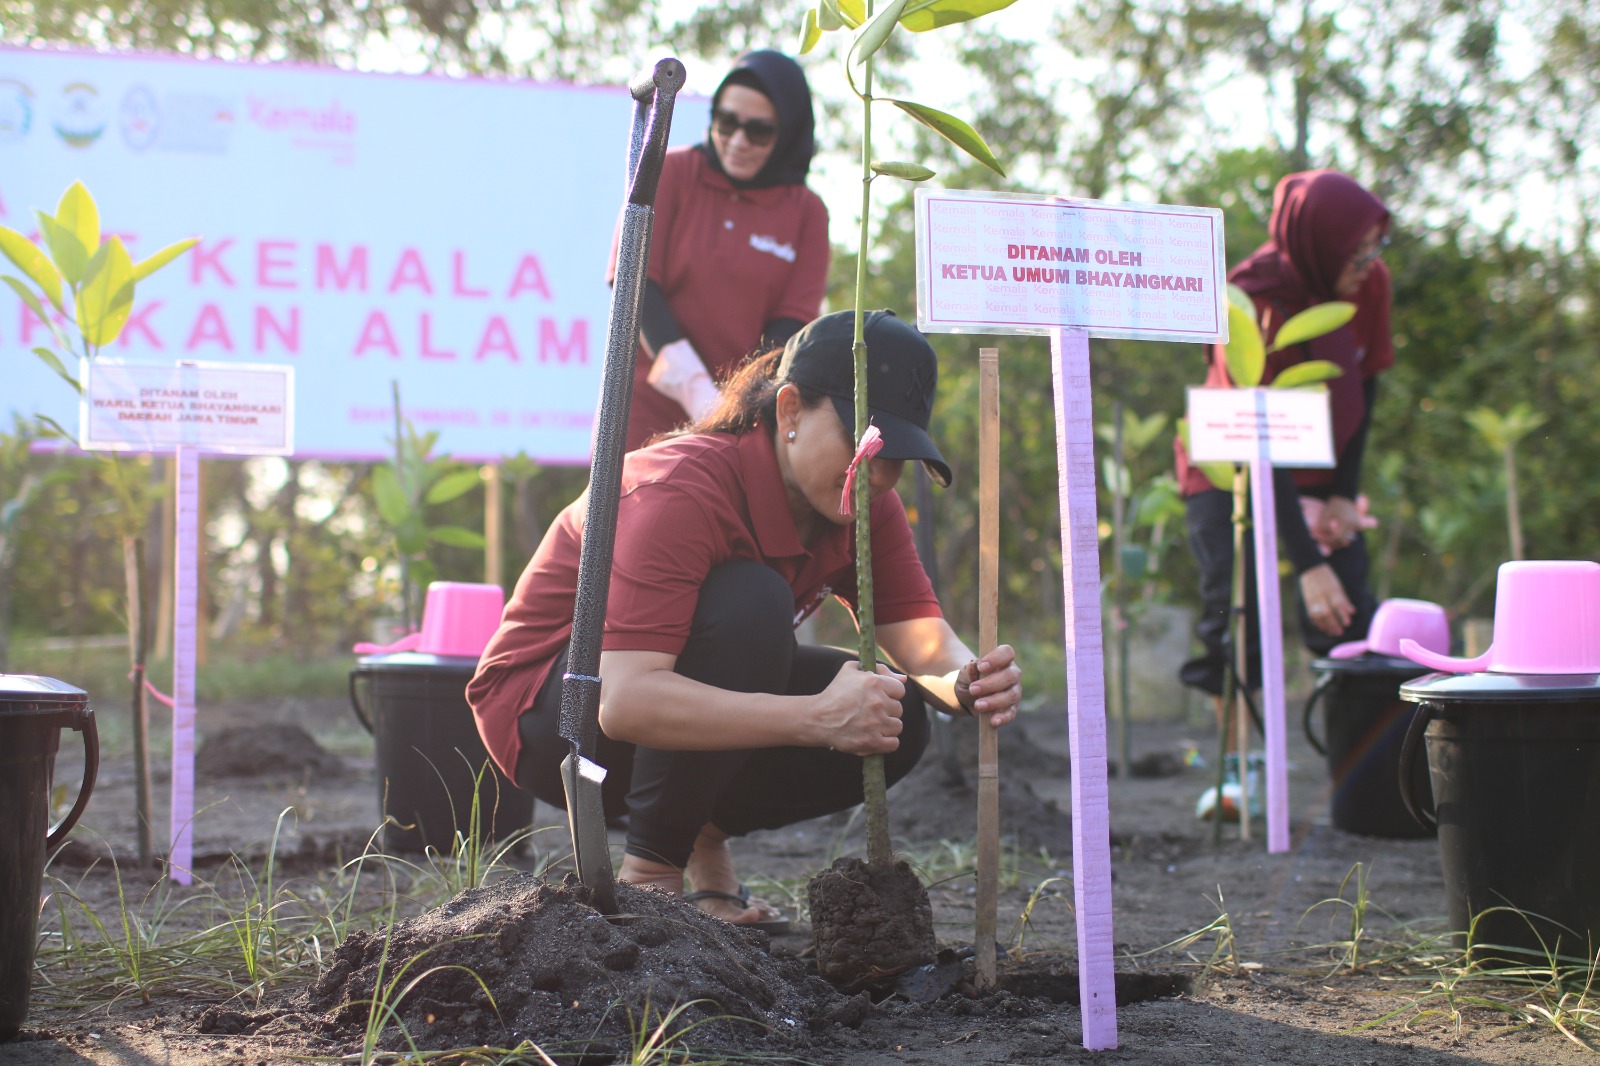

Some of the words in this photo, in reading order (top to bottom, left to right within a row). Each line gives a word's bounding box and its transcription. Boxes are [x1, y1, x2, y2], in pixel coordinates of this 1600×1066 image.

[934, 203, 976, 215] Kemala
[983, 205, 1024, 217] Kemala
[1078, 212, 1117, 224] Kemala
[1124, 215, 1162, 226] Kemala
[1169, 218, 1207, 230] Kemala
[984, 224, 1025, 236] Kemala
[1032, 227, 1072, 239] Kemala
[1079, 230, 1118, 242] Kemala
[1124, 234, 1163, 245] Kemala
[1169, 236, 1208, 248] Kemala
[1007, 244, 1090, 263] DITANAM
[1095, 249, 1142, 266] OLEH
[1170, 254, 1208, 266] Kemala
[190, 236, 553, 301] KEMALA
[942, 264, 1007, 281] KETUA
[1013, 266, 1070, 284] UMUM
[1075, 270, 1203, 292] BHAYANGKARI
[985, 283, 1027, 294] Kemala
[1081, 287, 1120, 298] Kemala
[1127, 290, 1166, 301] Kemala
[1172, 292, 1210, 304] Kemala
[986, 301, 1027, 313] Kemala
[1034, 303, 1075, 314] Kemala
[1082, 305, 1121, 317] Kemala
[1128, 307, 1167, 320] Kemala
[1172, 311, 1212, 322] Kemala
[353, 309, 589, 365] ALAM
